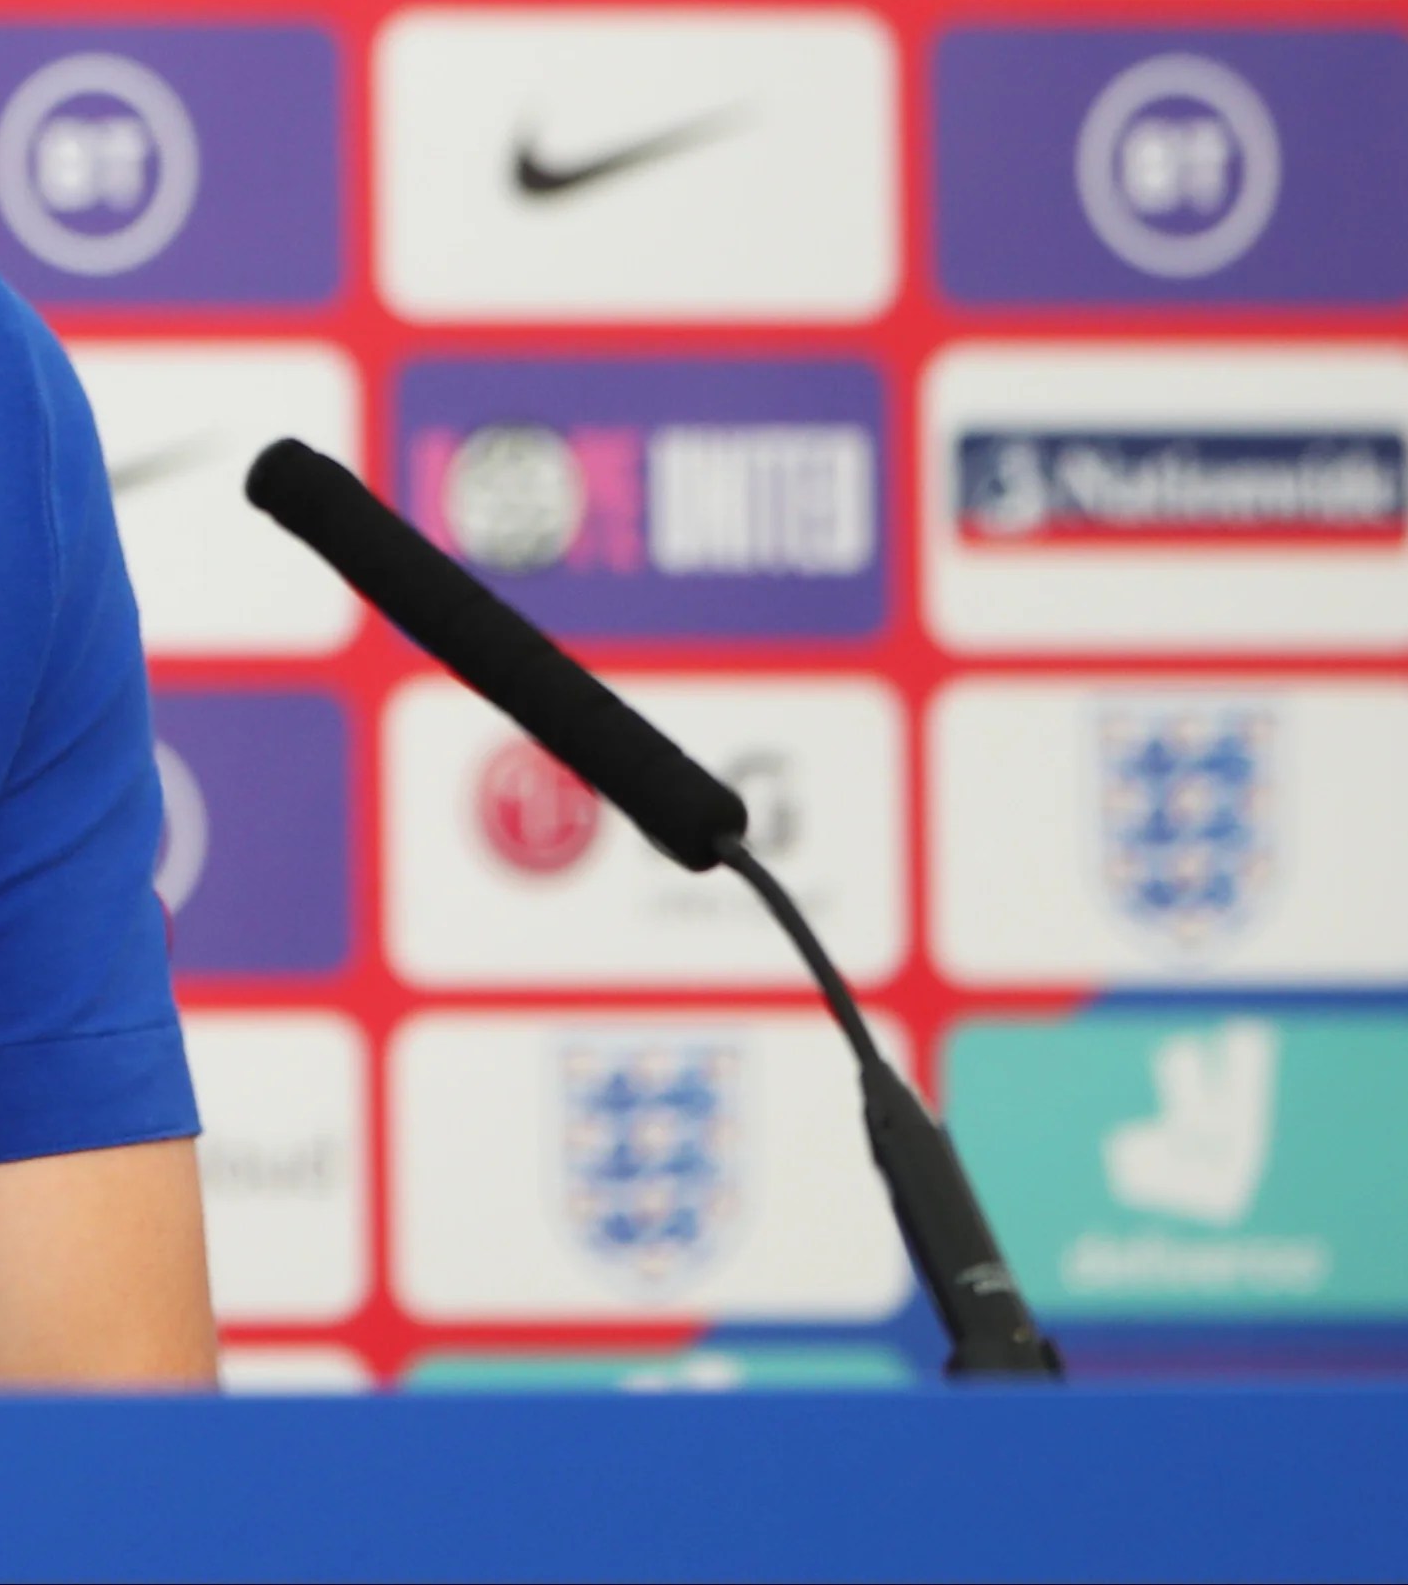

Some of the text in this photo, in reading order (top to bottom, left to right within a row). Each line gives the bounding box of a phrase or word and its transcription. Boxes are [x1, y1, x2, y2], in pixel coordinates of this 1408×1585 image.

[35, 114, 147, 213] BT
[1121, 117, 1227, 215] BT
[650, 425, 872, 575] UNITED
[1058, 437, 1403, 525] Nationwide
